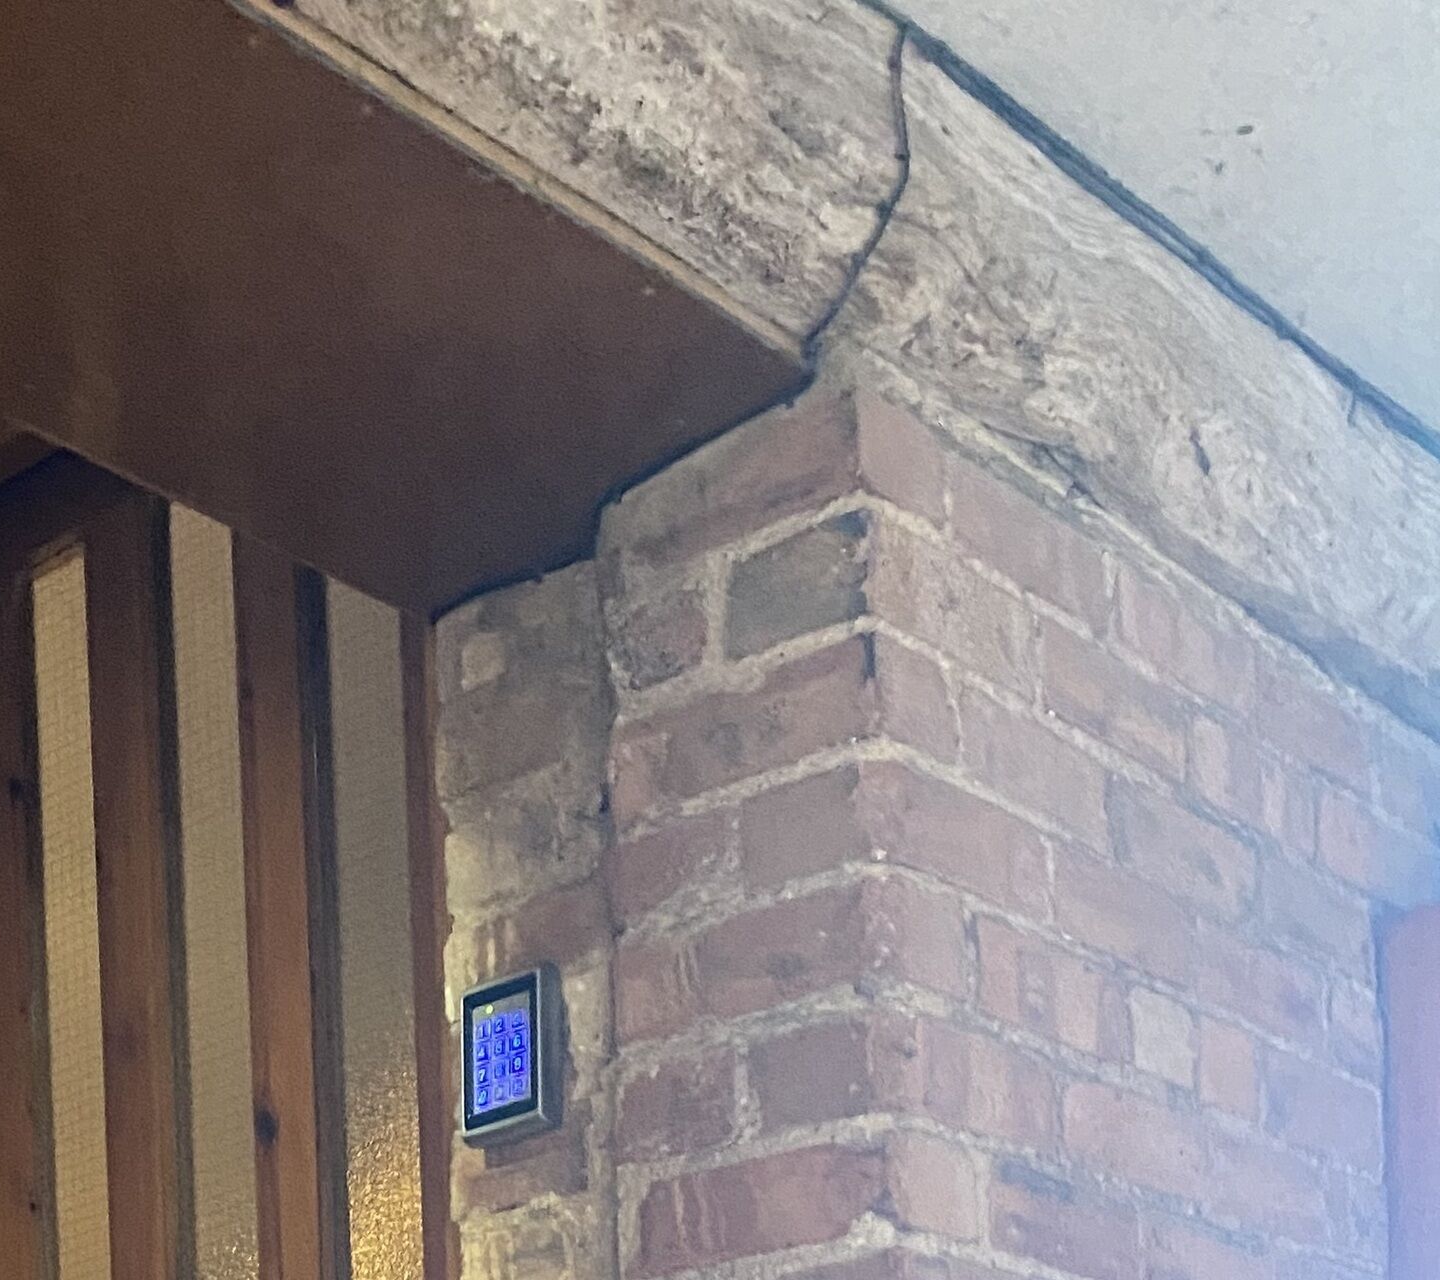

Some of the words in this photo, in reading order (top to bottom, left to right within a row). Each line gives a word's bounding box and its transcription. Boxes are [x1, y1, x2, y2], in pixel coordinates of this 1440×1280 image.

[495, 1018, 503, 1032] 2
[513, 1034, 521, 1048] 6
[478, 1068, 486, 1082] 7
[513, 1057, 522, 1070] 9
